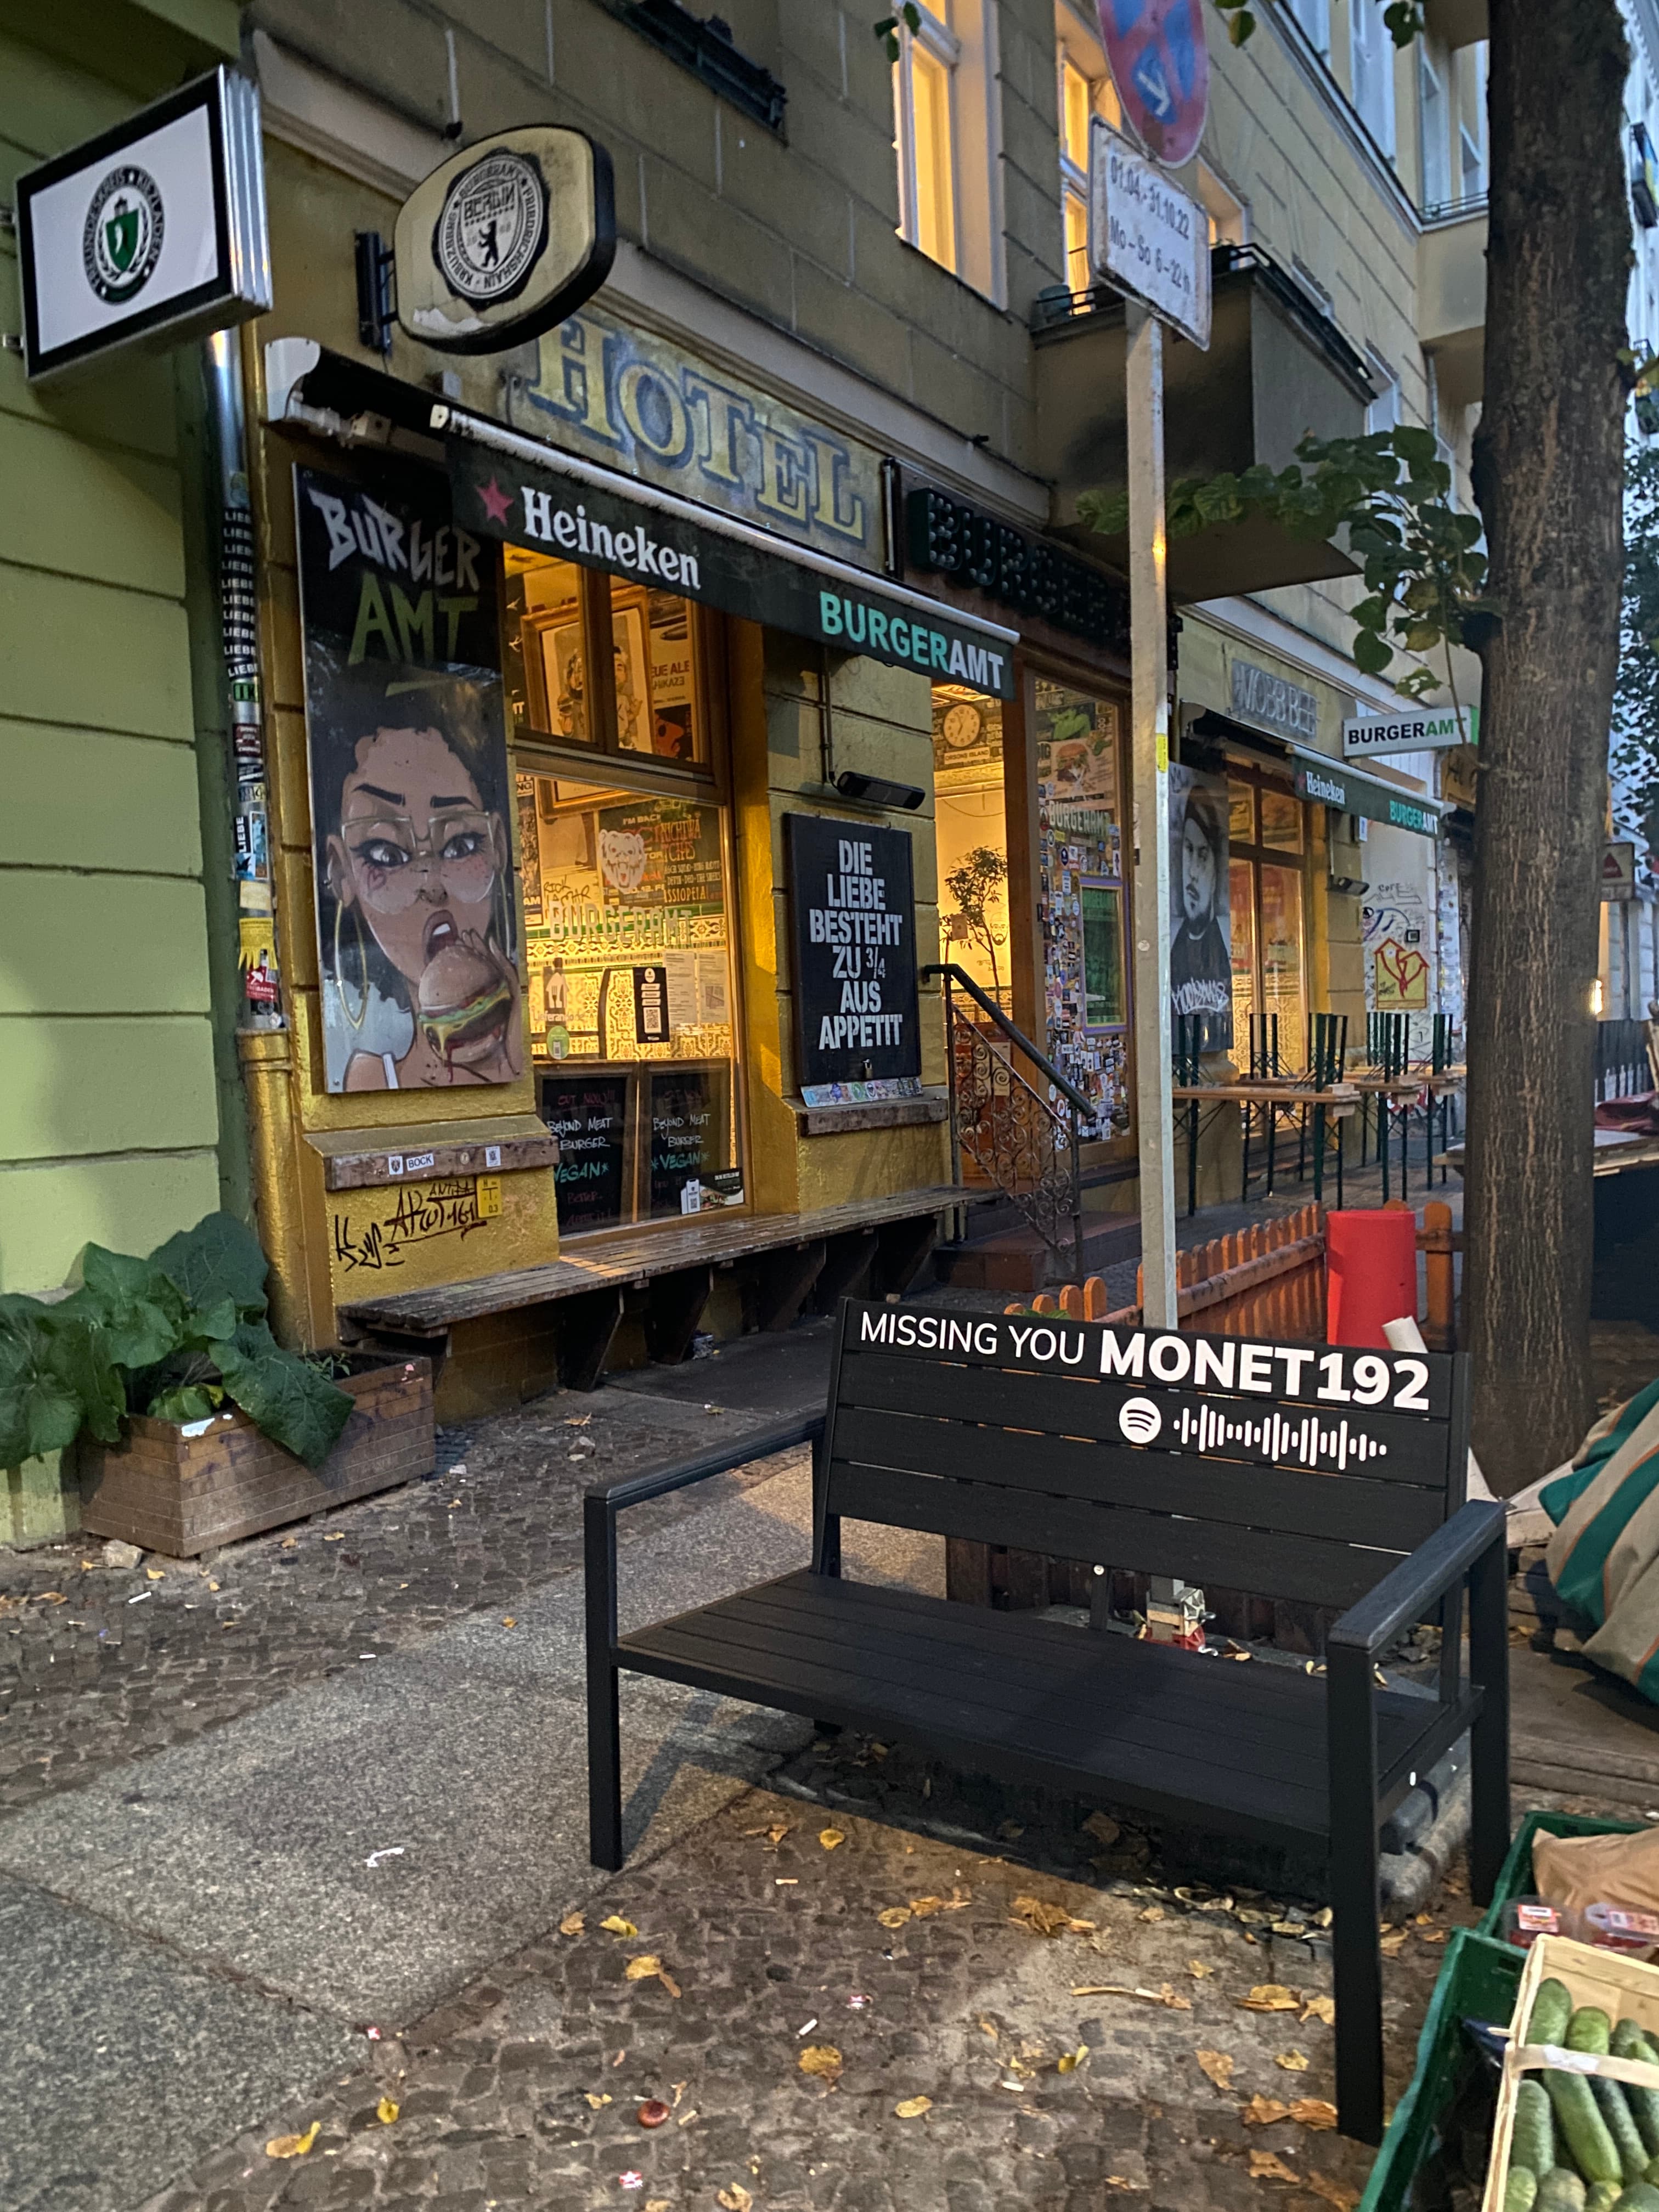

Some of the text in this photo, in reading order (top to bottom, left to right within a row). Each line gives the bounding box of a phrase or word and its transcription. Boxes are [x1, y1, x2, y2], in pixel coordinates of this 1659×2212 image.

[529, 315, 867, 547] HOTEL
[307, 487, 481, 593] BURGER
[520, 486, 702, 592] Heineken
[348, 571, 478, 665] AMT
[820, 590, 1004, 690] BURGERAMT
[670, 660, 690, 675] ALE
[1306, 771, 1345, 804] Heineken
[236, 816, 247, 853] LIEBE
[1390, 800, 1438, 834] BURGERAMT
[838, 839, 873, 876] DIE
[827, 874, 885, 910] LIEBE
[549, 900, 692, 945] BURGERAMT
[809, 909, 903, 945] BESTEHT
[832, 945, 861, 979] ZU
[840, 980, 882, 1014] AUS
[819, 1013, 903, 1050] APPETIT
[588, 1116, 613, 1132] MEAT
[689, 1113, 712, 1126] MEAT
[560, 1136, 610, 1150] BURGER
[668, 1135, 704, 1148] BURGER
[408, 1155, 432, 1168] BOCK
[861, 1311, 1429, 1410] MISSING YOU MONET192
